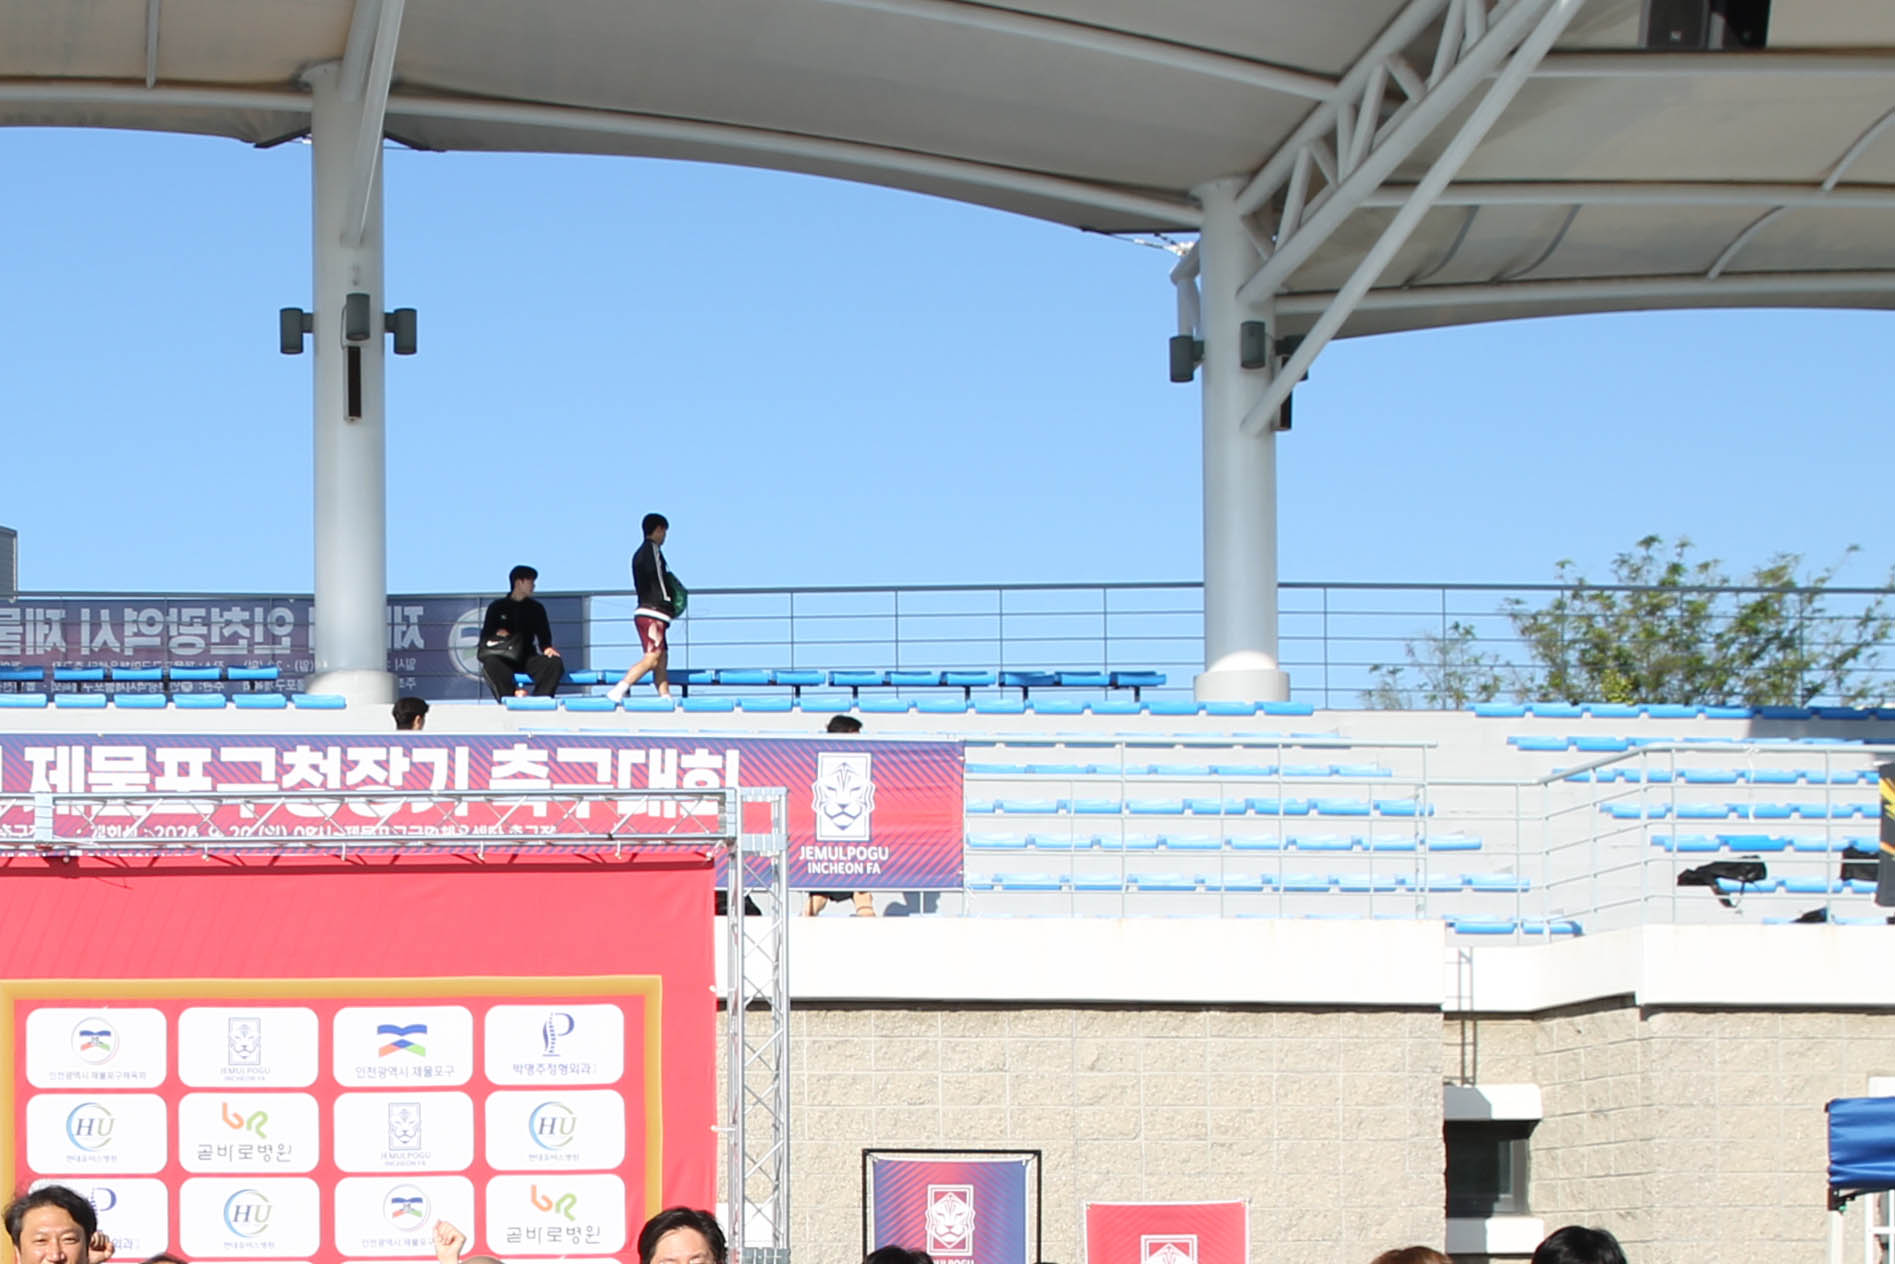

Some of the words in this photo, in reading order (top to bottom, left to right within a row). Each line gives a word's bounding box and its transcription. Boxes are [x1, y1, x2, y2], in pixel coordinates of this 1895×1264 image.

[24, 745, 469, 818] 제물포구청장기
[489, 744, 740, 819] 축구대회
[799, 846, 890, 861] JEMULPOGU
[807, 862, 863, 874] INCHEON
[867, 862, 881, 874] FA
[355, 1065, 409, 1079] 인천광역시
